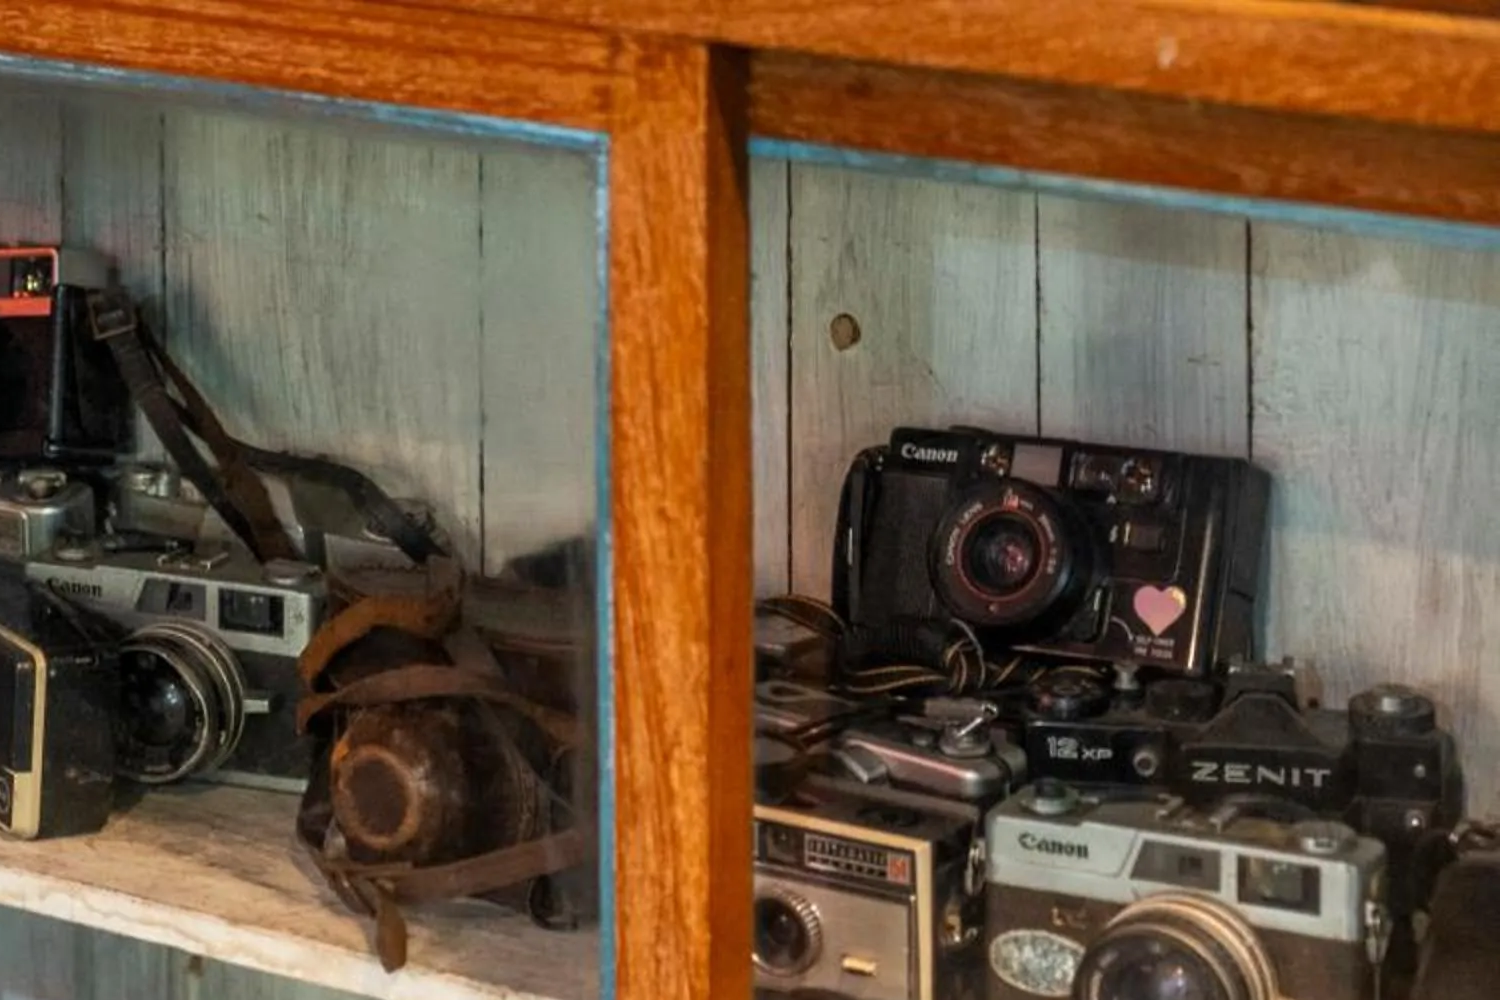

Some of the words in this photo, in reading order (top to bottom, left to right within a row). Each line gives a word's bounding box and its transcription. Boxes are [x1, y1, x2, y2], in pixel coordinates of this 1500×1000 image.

[901, 442, 959, 463] Canon
[1191, 761, 1331, 787] ZENIT
[1018, 832, 1090, 860] Canon
